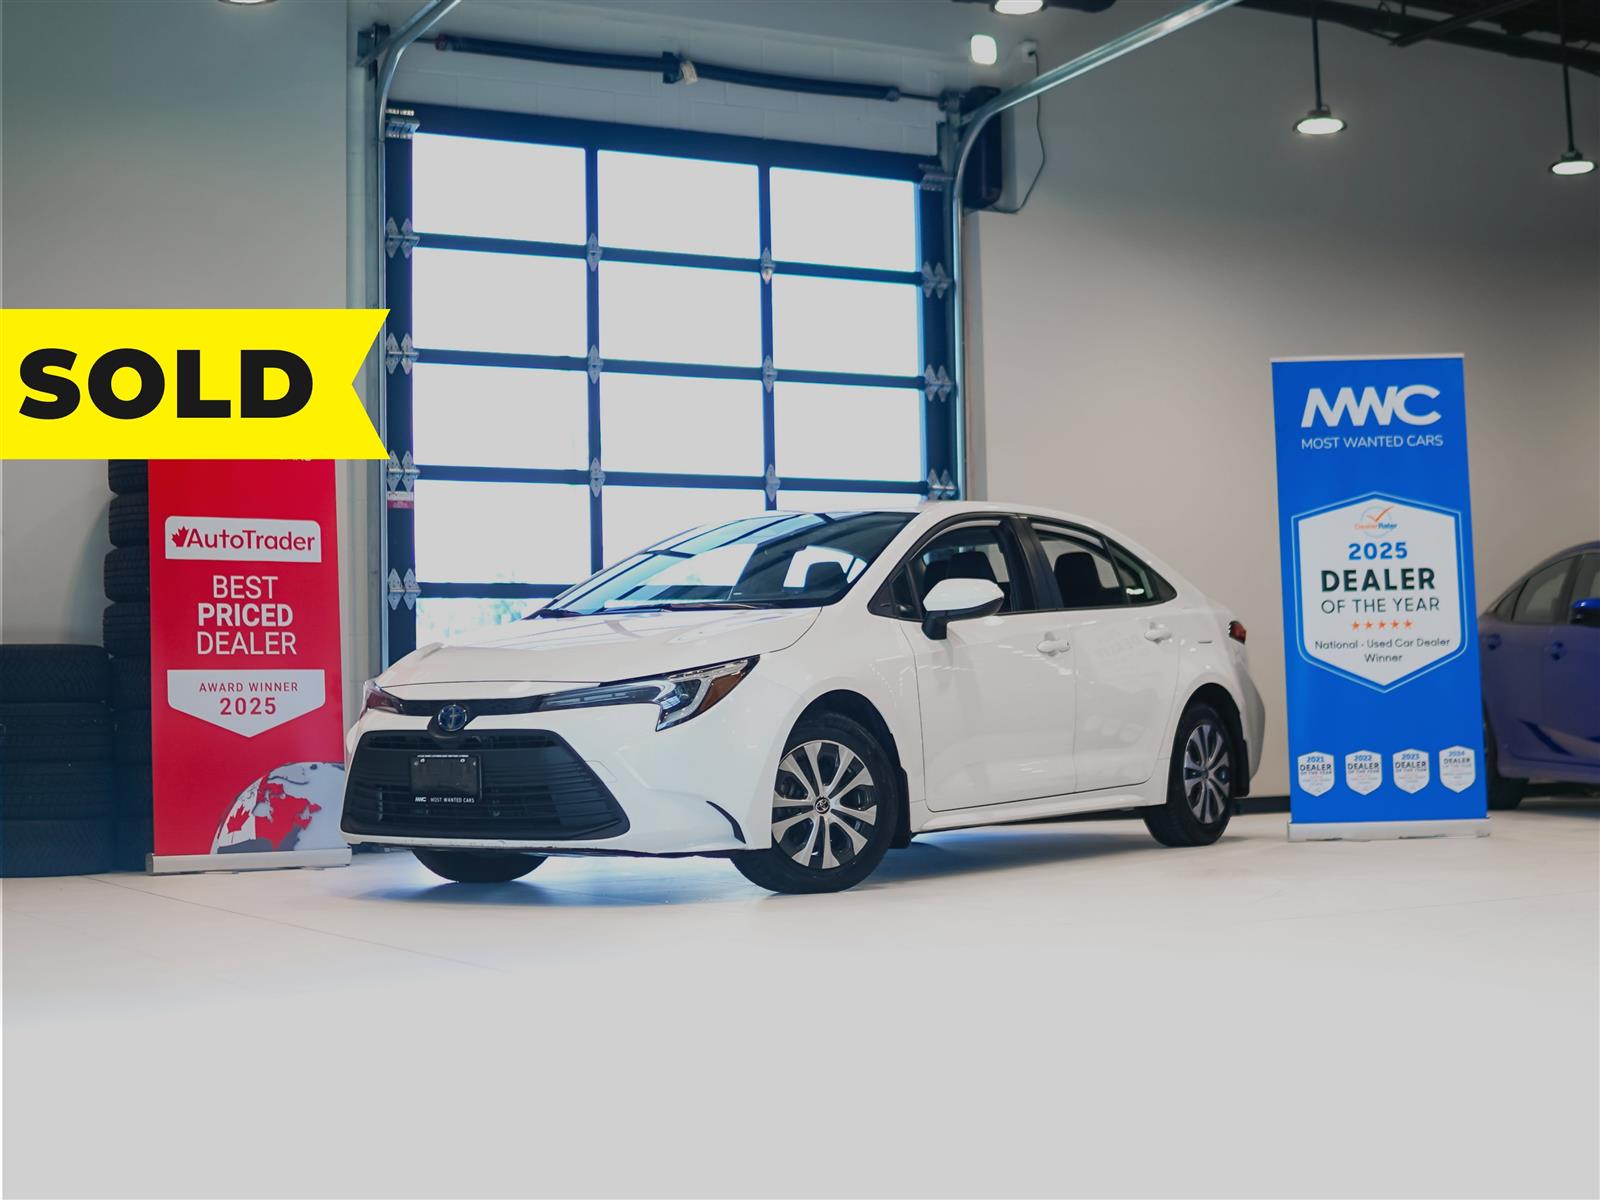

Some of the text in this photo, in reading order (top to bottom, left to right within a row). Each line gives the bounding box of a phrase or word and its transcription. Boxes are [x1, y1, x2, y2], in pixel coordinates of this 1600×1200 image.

[1300, 384, 1442, 428] MWC
[1301, 434, 1444, 449] MOST WANTED CARS
[186, 527, 316, 551] AutoTrader
[1348, 542, 1408, 560] 2025
[212, 574, 278, 599] BEST
[1320, 567, 1435, 593] DEALER
[197, 602, 294, 627] PRICED
[1320, 597, 1440, 614] OF THE YEAR
[196, 631, 297, 655] DEALER
[1314, 640, 1358, 650] National
[1366, 639, 1393, 649] Used
[1395, 638, 1414, 648] Car
[1416, 637, 1450, 647] Dealer
[1364, 653, 1403, 663] Winner
[199, 681, 299, 693] AWARD WINNER
[220, 697, 277, 715] 2025
[1395, 761, 1427, 769] DEALER
